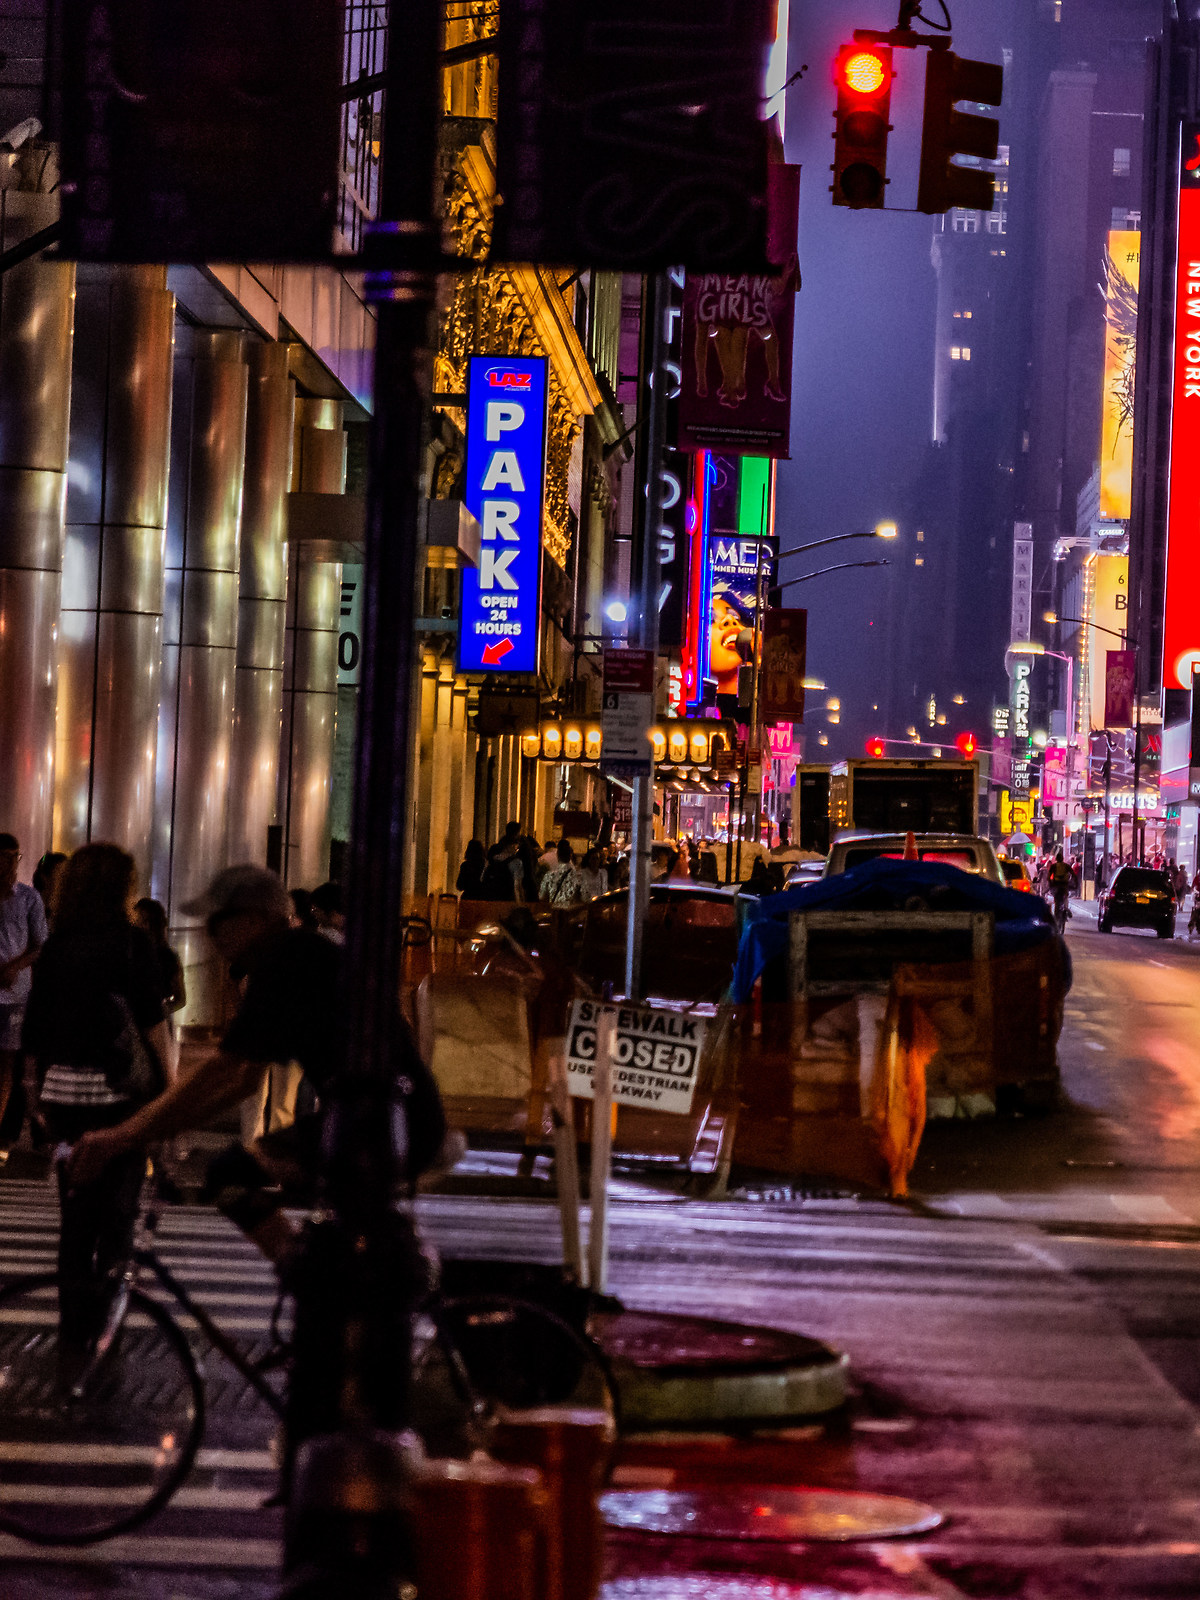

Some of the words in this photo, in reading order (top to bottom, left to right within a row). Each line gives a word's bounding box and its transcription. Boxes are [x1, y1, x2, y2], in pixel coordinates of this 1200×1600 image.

[700, 292, 767, 326] GIRLS
[489, 372, 531, 387] LAZ
[480, 401, 526, 591] PARK
[481, 596, 518, 608] OPEN
[490, 610, 507, 621] 24
[475, 622, 521, 635] HOURS
[1016, 665, 1030, 724] PARK
[579, 1002, 698, 1040] SIEWALK
[575, 1030, 692, 1075] COSED
[613, 1070, 690, 1093] DESTRIAN
